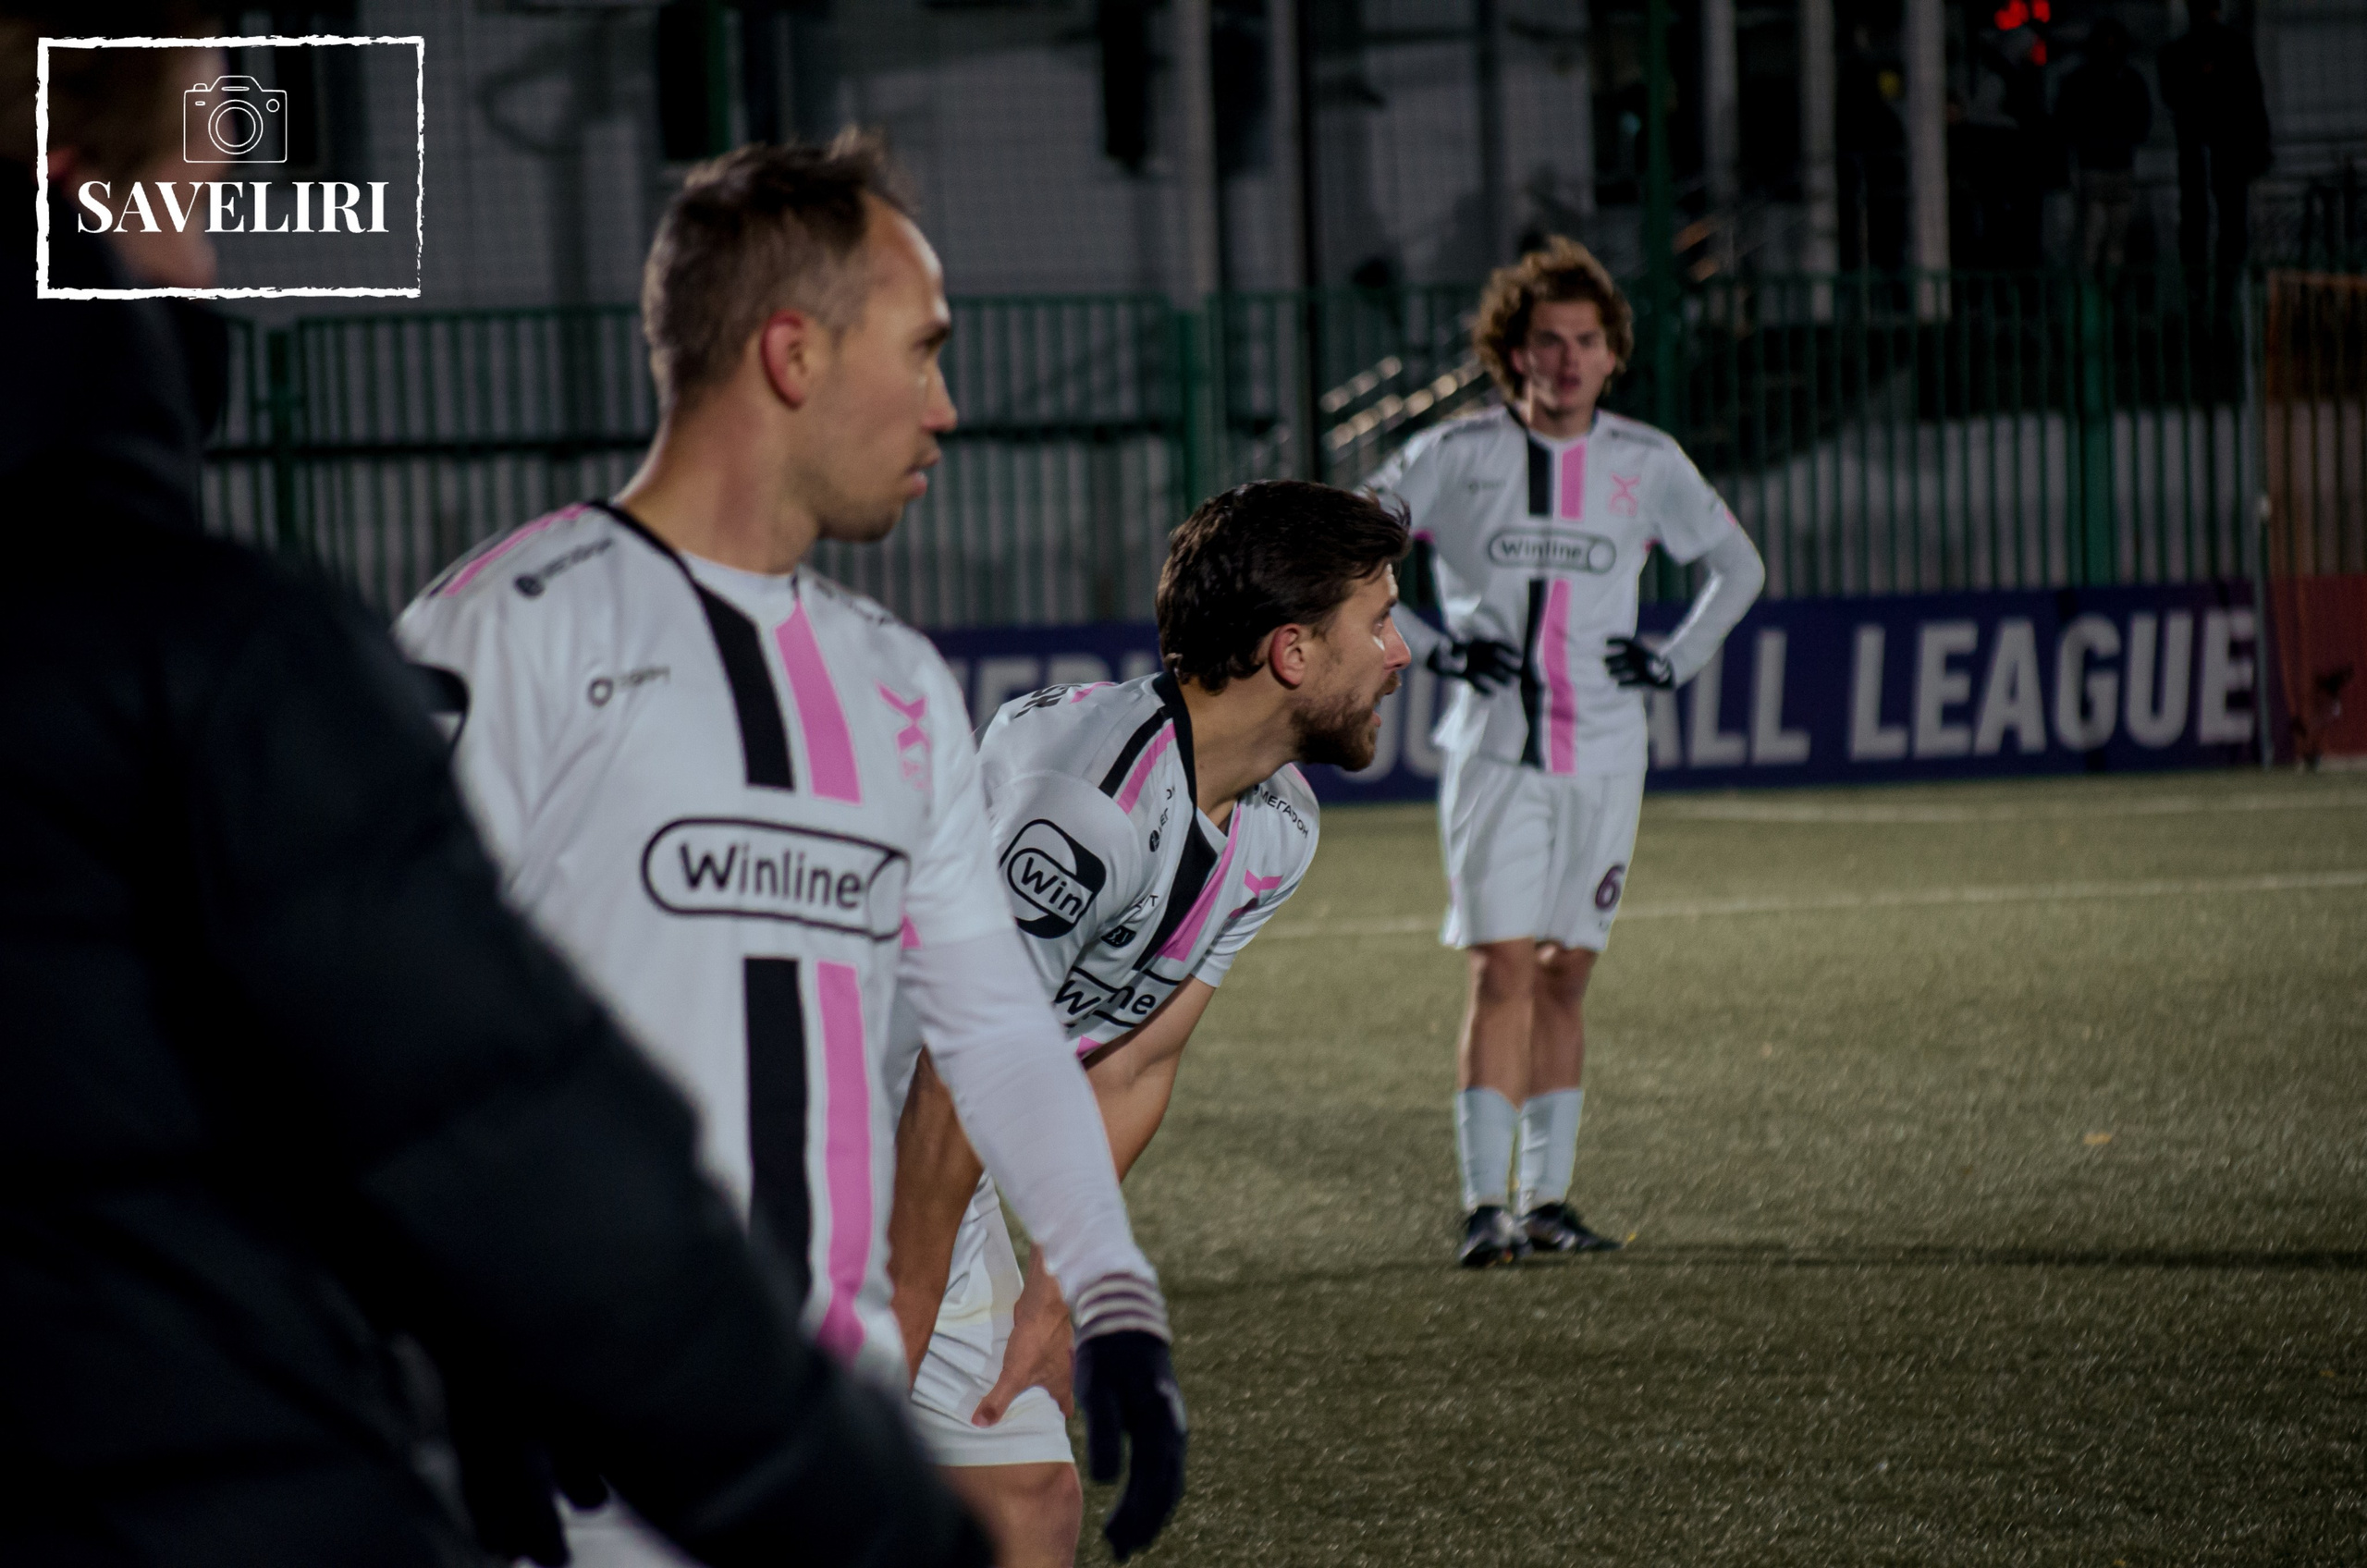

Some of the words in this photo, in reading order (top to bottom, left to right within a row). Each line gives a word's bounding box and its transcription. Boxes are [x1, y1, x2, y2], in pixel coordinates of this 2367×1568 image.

[1501, 539, 1582, 559] Winline
[1849, 607, 2257, 761] LEAGUE
[679, 841, 862, 910] Winline
[1021, 856, 1084, 917] Win
[1594, 863, 1625, 913] 6
